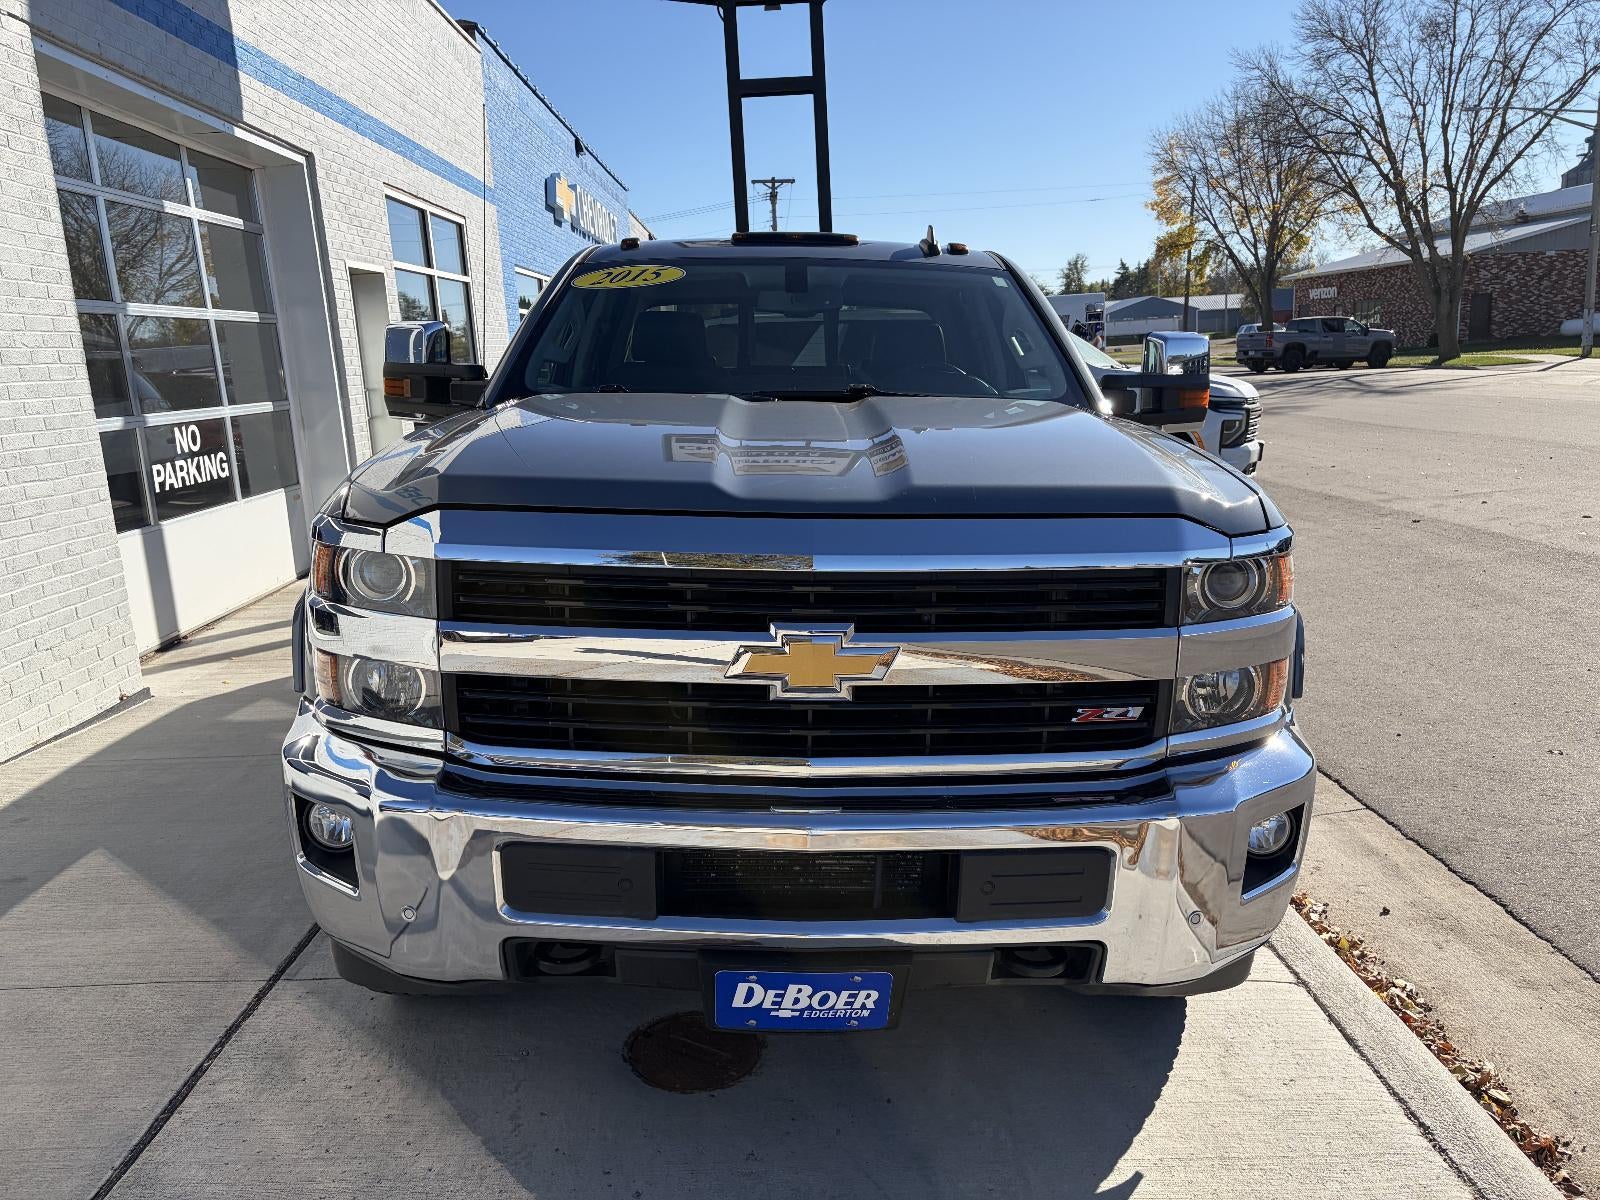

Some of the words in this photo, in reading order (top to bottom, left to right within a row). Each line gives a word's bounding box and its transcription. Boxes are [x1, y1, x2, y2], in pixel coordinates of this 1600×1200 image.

[590, 267, 667, 285] 2015
[1309, 286, 1338, 300] verizon
[174, 424, 200, 454] NO
[152, 452, 229, 493] PARKING
[1071, 706, 1144, 722] Z71
[803, 1009, 871, 1018] EDGERTON
